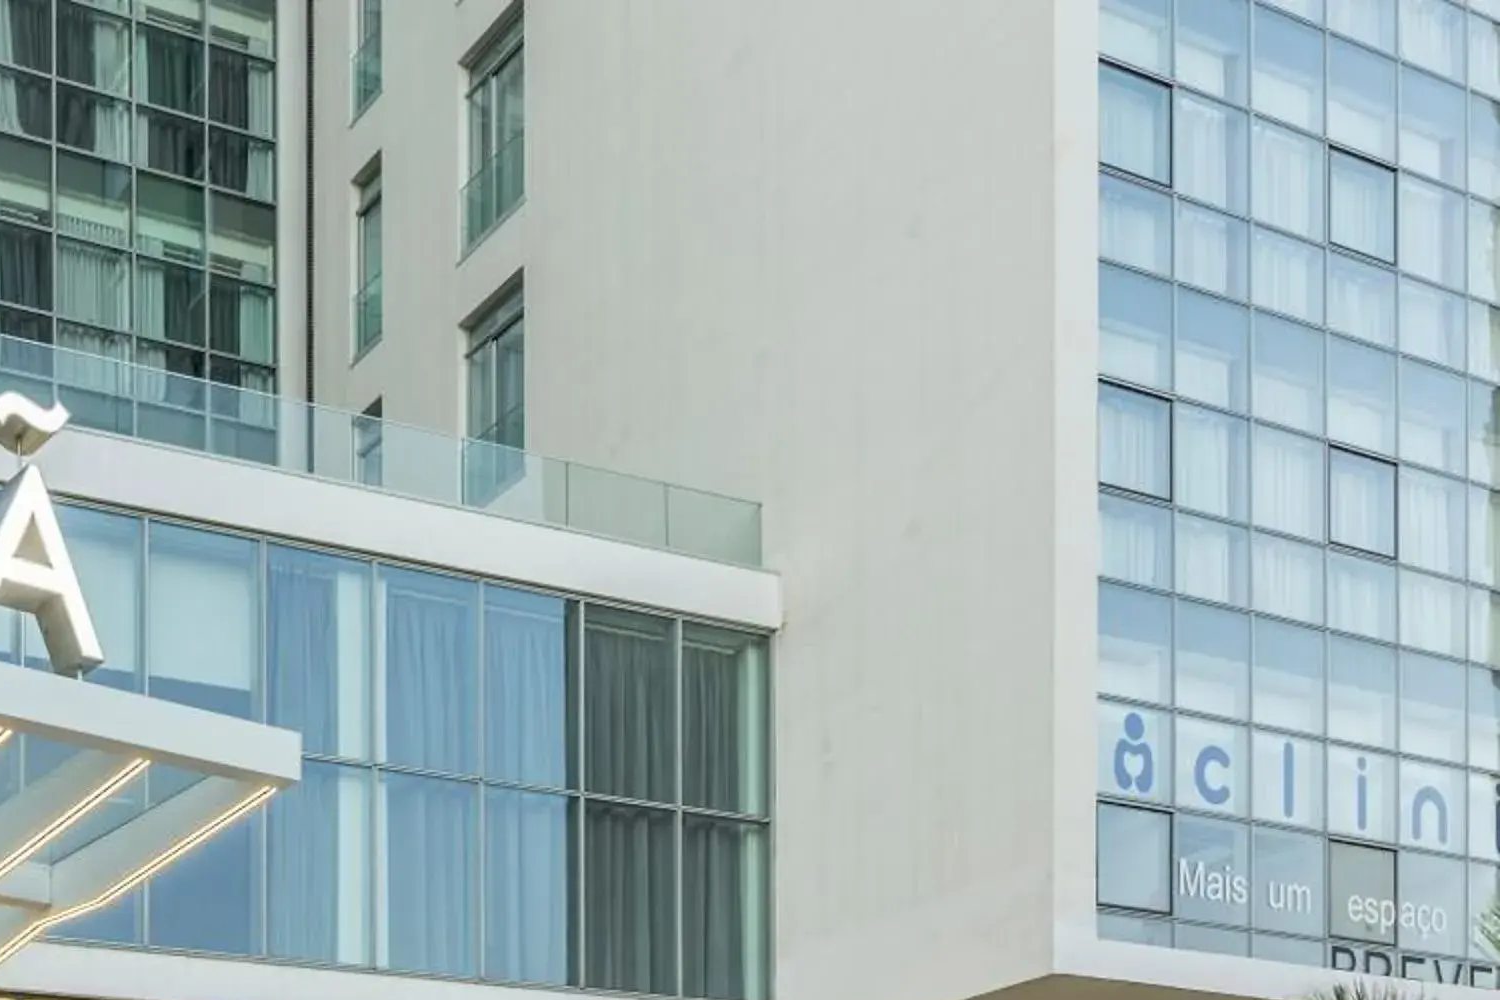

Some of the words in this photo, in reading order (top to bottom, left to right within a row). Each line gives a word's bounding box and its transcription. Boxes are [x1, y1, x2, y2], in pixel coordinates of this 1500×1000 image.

[1178, 857, 1249, 905] Mais
[1269, 877, 1312, 913] um
[1347, 893, 1448, 938] espaço
